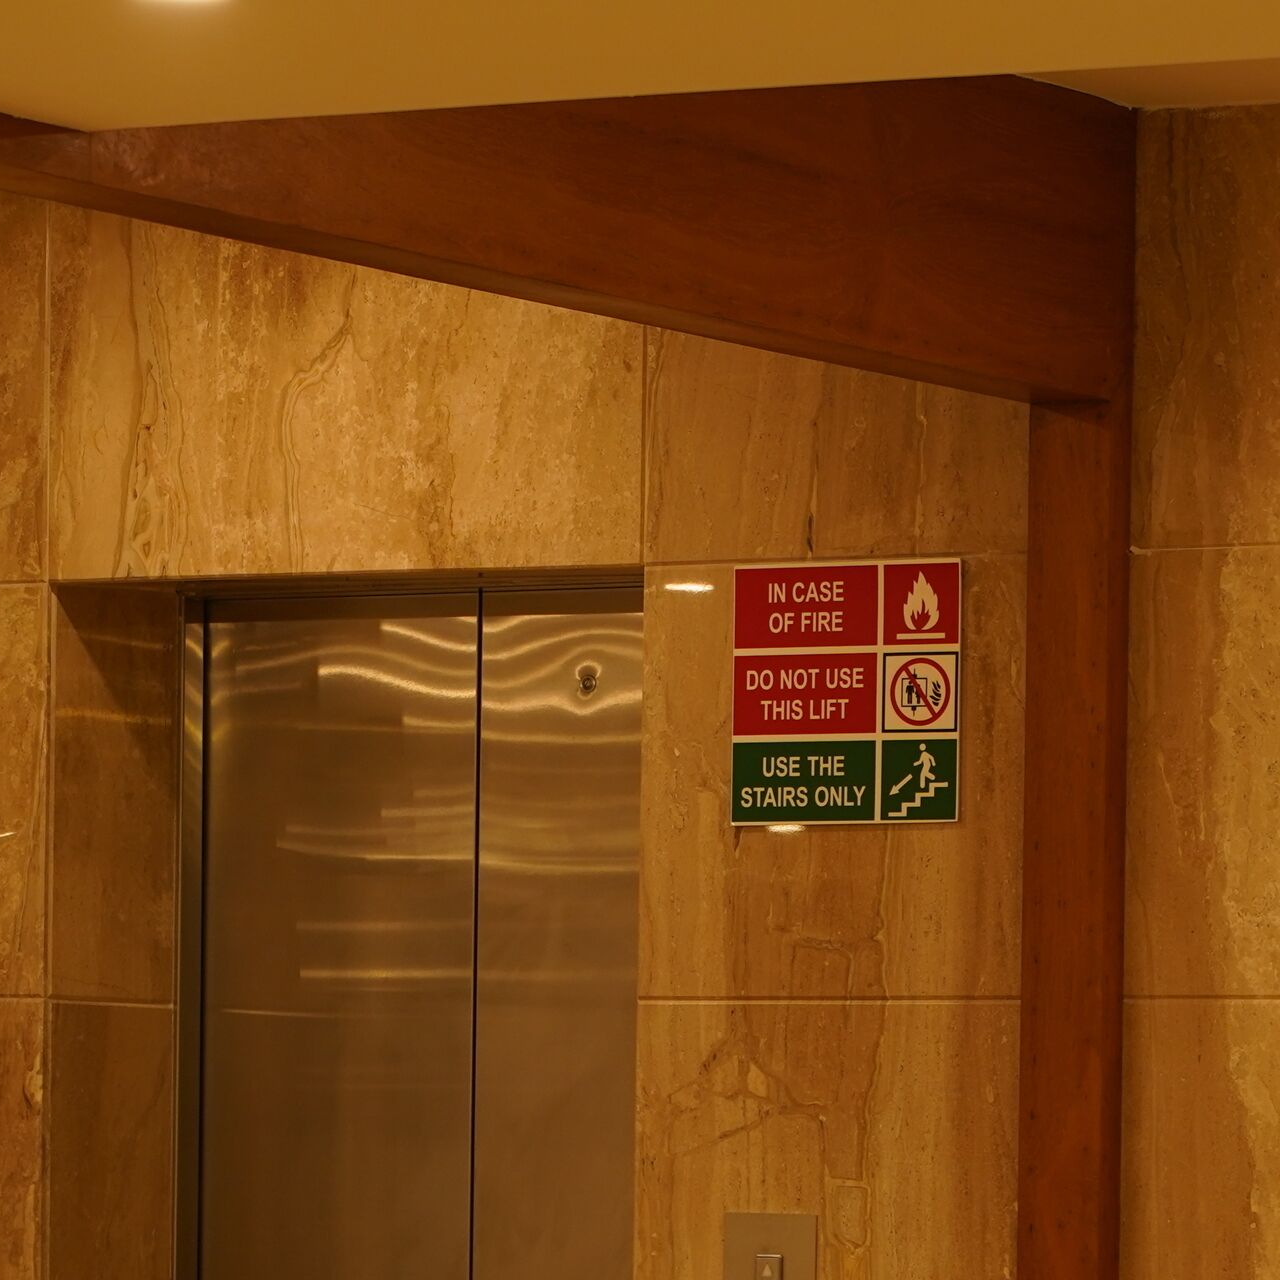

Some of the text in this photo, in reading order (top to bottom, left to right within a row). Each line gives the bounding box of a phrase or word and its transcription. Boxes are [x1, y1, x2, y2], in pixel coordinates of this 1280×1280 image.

[768, 581, 845, 604] IN CASE
[769, 611, 844, 633] OF FIRE
[746, 667, 864, 690] DO NOT USE
[760, 698, 850, 720] THIS LIFT
[762, 755, 845, 777] USE THE
[740, 785, 866, 808] STAIRS ONLY
